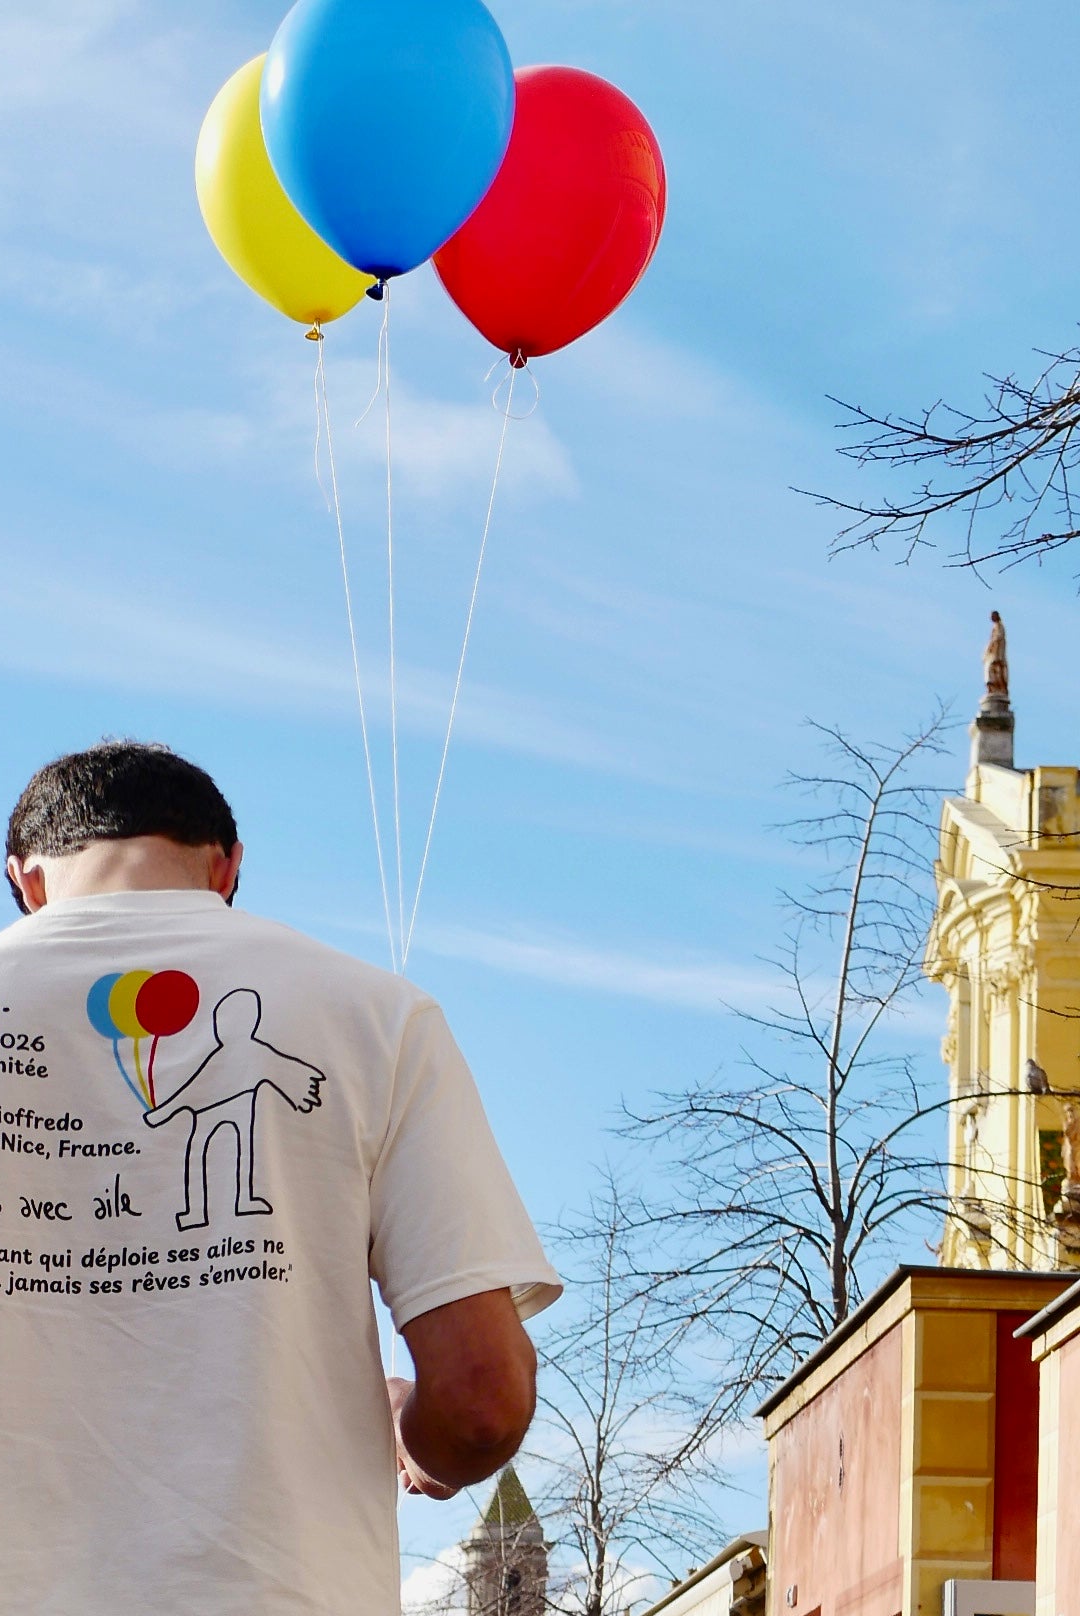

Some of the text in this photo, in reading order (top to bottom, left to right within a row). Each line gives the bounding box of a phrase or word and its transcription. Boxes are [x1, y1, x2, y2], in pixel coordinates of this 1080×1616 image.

[1, 1132, 51, 1160] Nice,
[58, 1140, 142, 1158] France.
[19, 1196, 73, 1221] avec
[93, 1173, 143, 1220] aile
[39, 1249, 72, 1273] qui
[81, 1246, 160, 1274] déploie
[166, 1247, 200, 1263] ses
[206, 1236, 256, 1260] ailes
[263, 1239, 285, 1255] ne
[5, 1271, 82, 1296] jamais
[89, 1279, 123, 1295] ses
[131, 1271, 191, 1293] rêves
